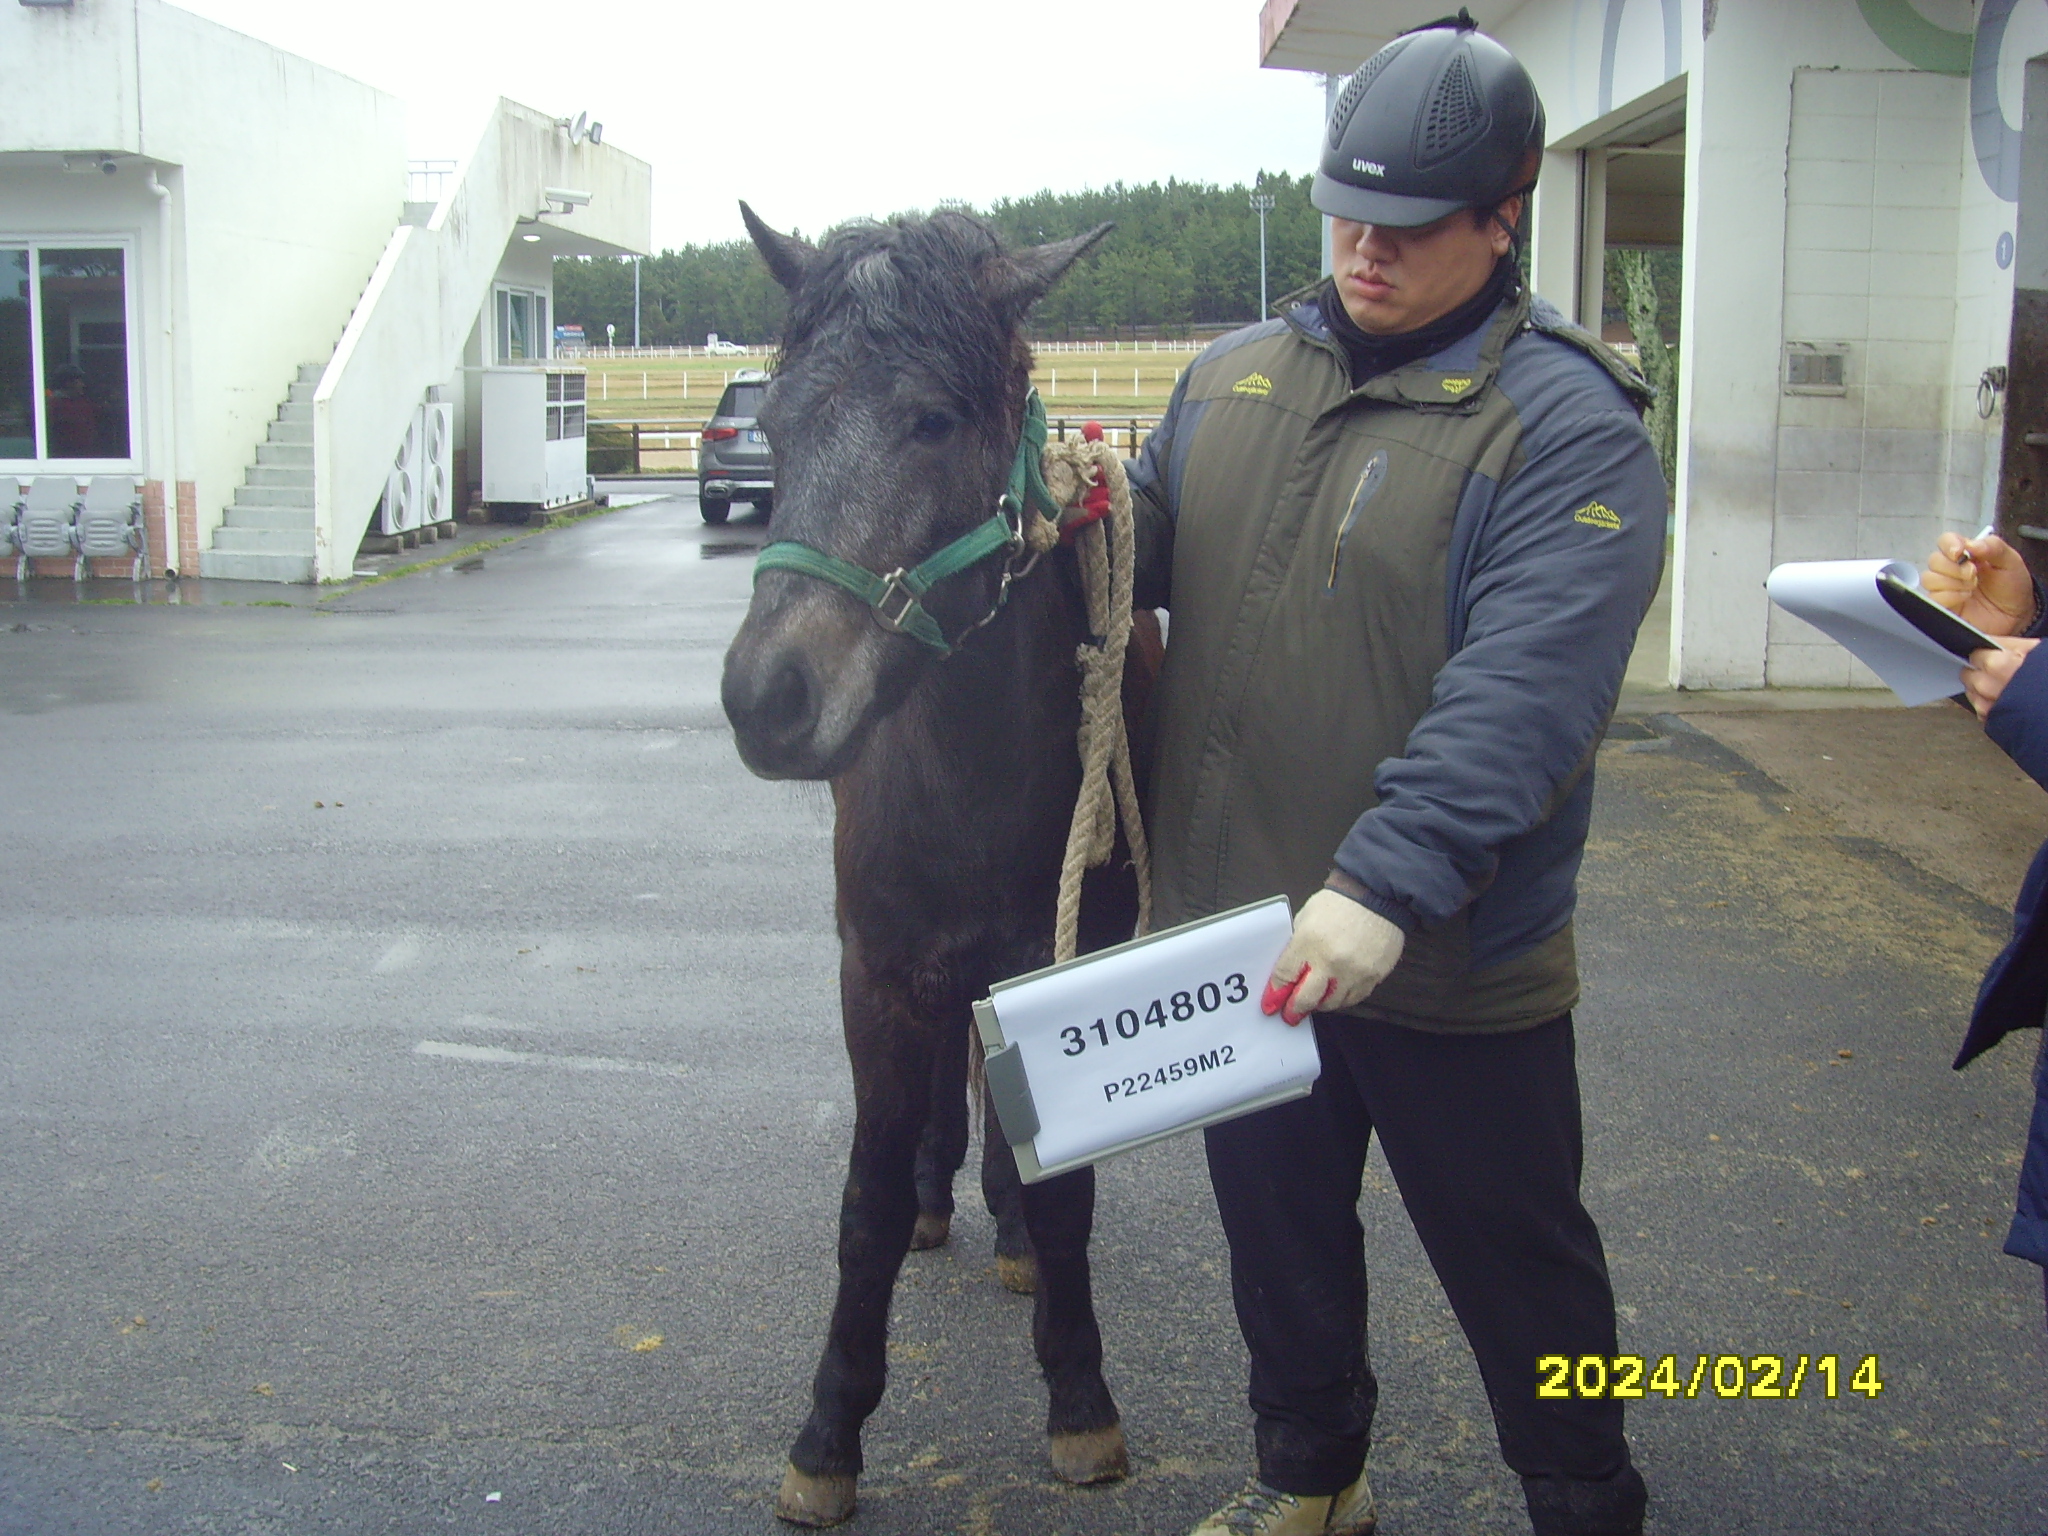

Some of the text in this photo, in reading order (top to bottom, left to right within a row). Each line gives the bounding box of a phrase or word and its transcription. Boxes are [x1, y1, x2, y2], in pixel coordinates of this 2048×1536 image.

[1352, 157, 1386, 178] uvex
[1060, 973, 1249, 1057] 3104803
[1103, 1045, 1237, 1103] P22459M2
